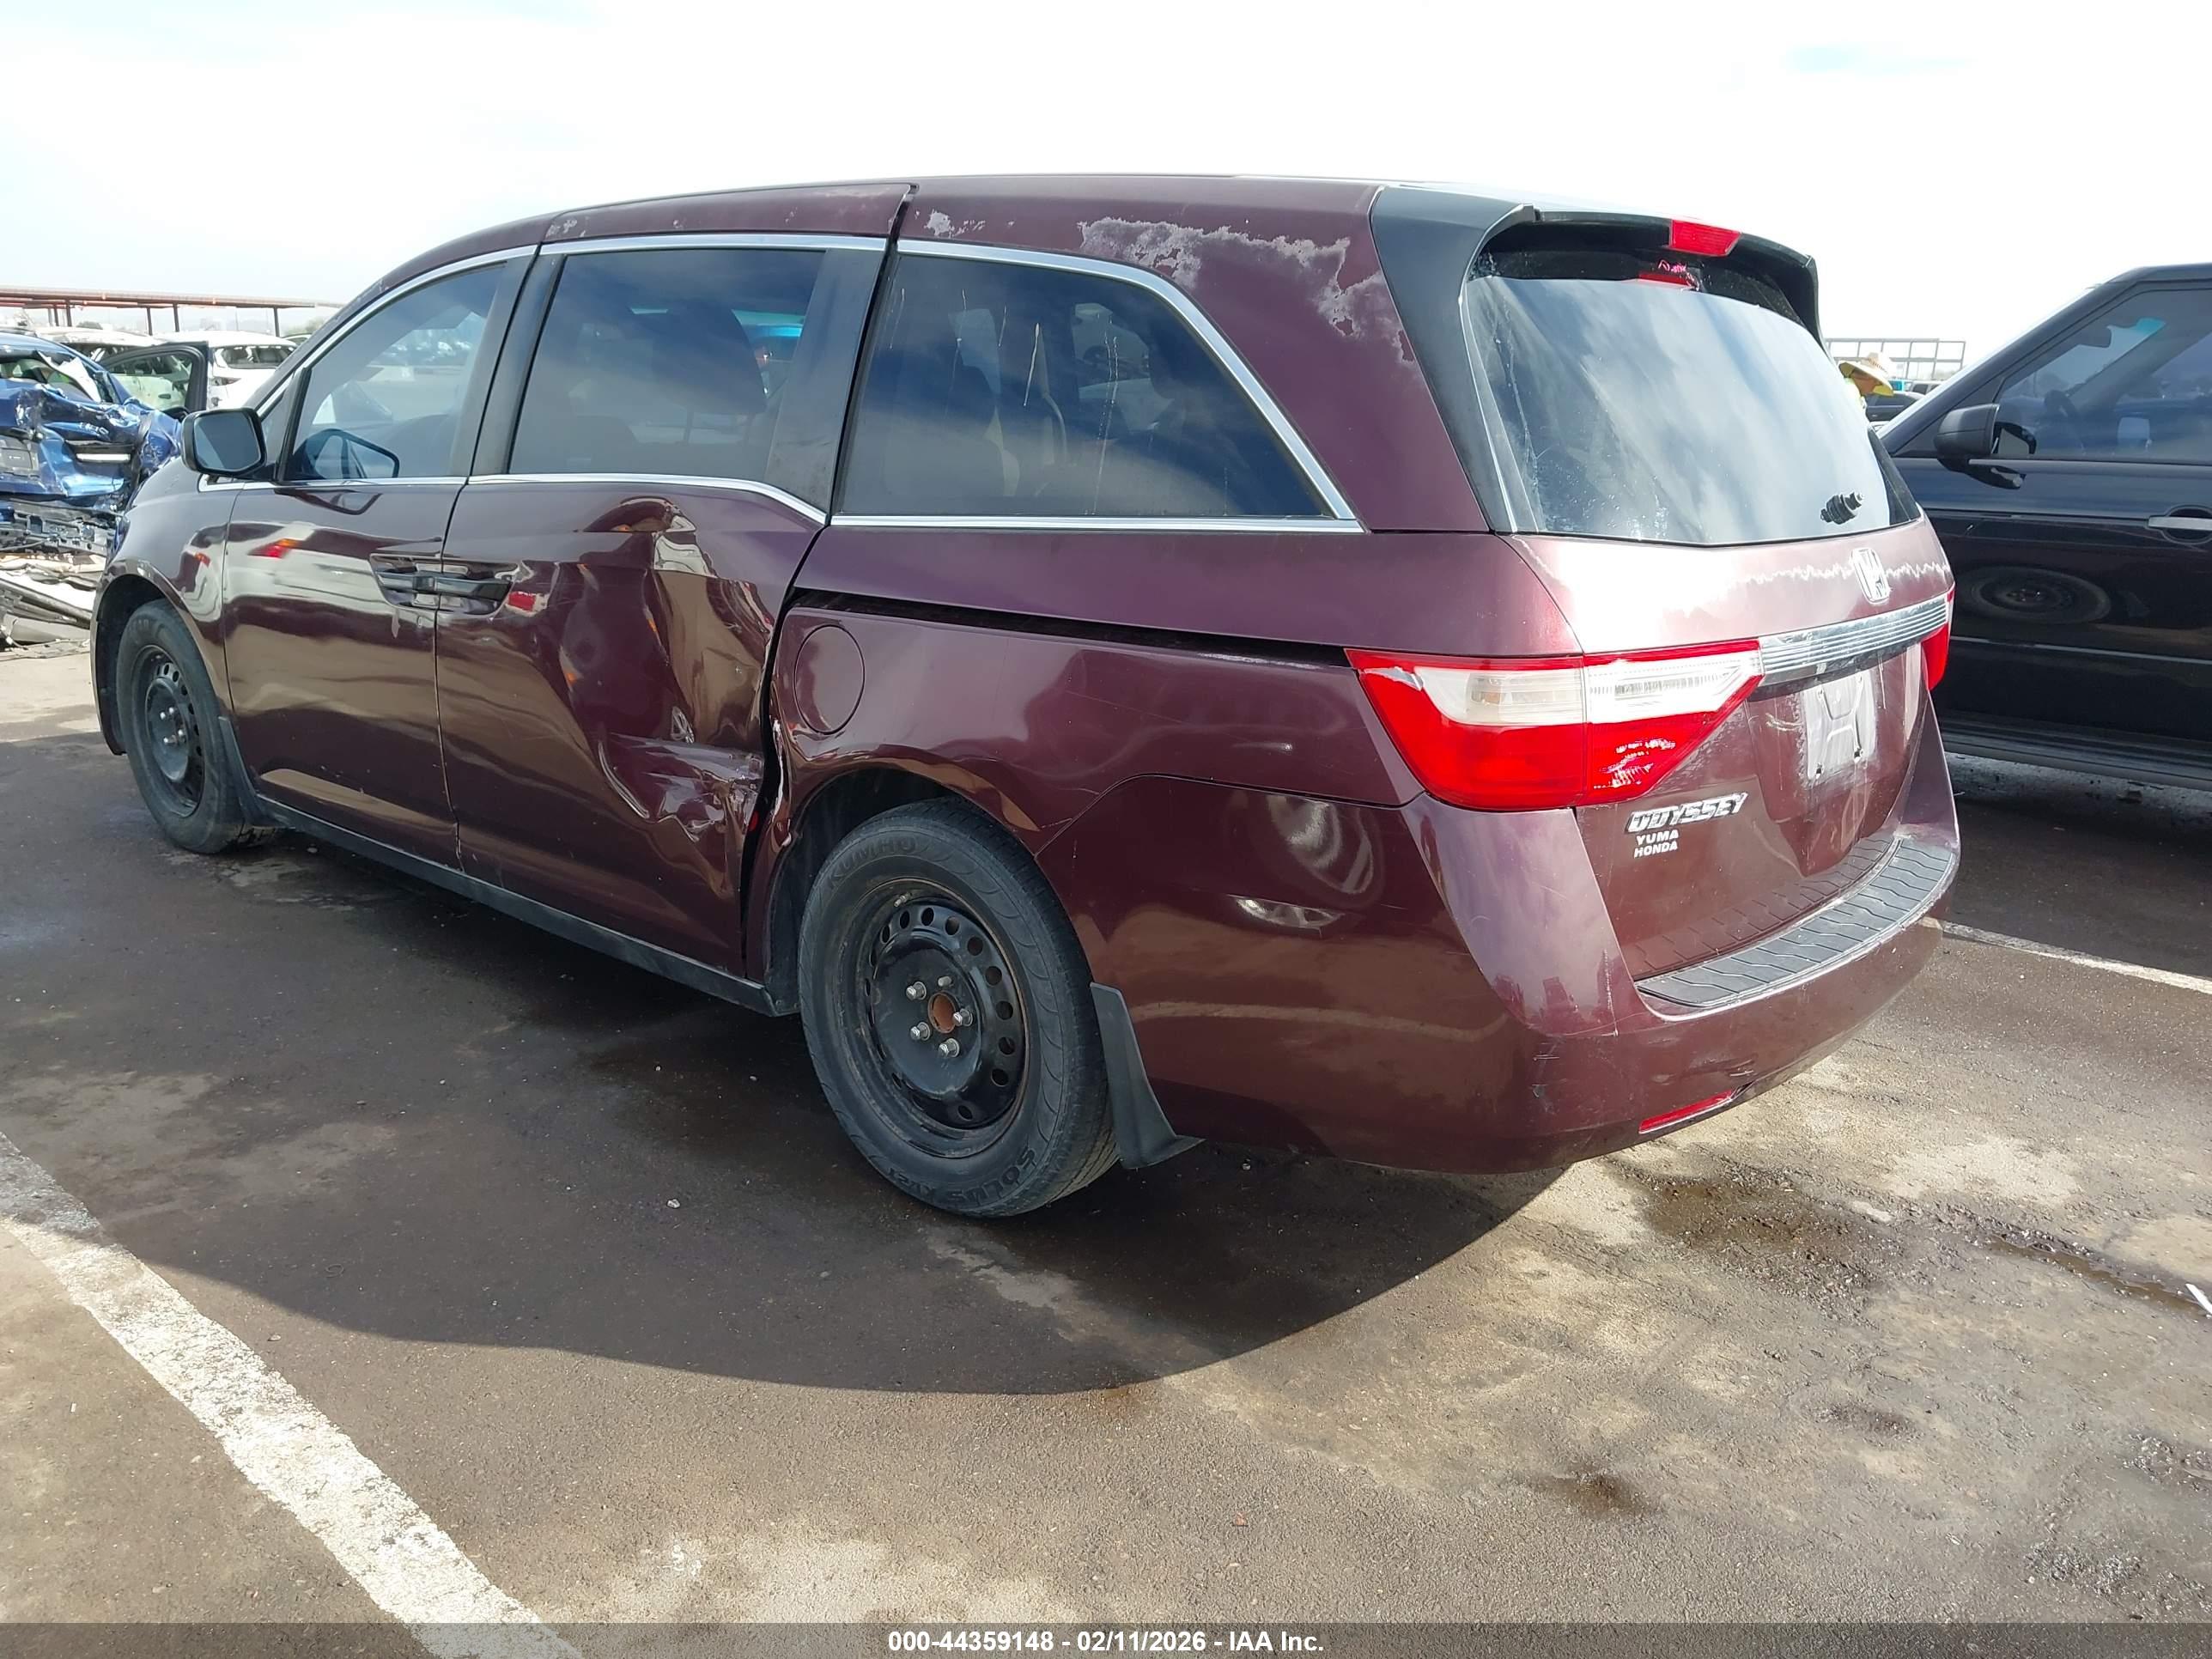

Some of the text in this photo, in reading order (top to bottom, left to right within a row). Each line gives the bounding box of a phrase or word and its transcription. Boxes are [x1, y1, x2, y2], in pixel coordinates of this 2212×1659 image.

[1626, 792, 1748, 833] ODYSSEY
[1636, 830, 1680, 846] YUMA
[1633, 841, 1679, 859] HONDA
